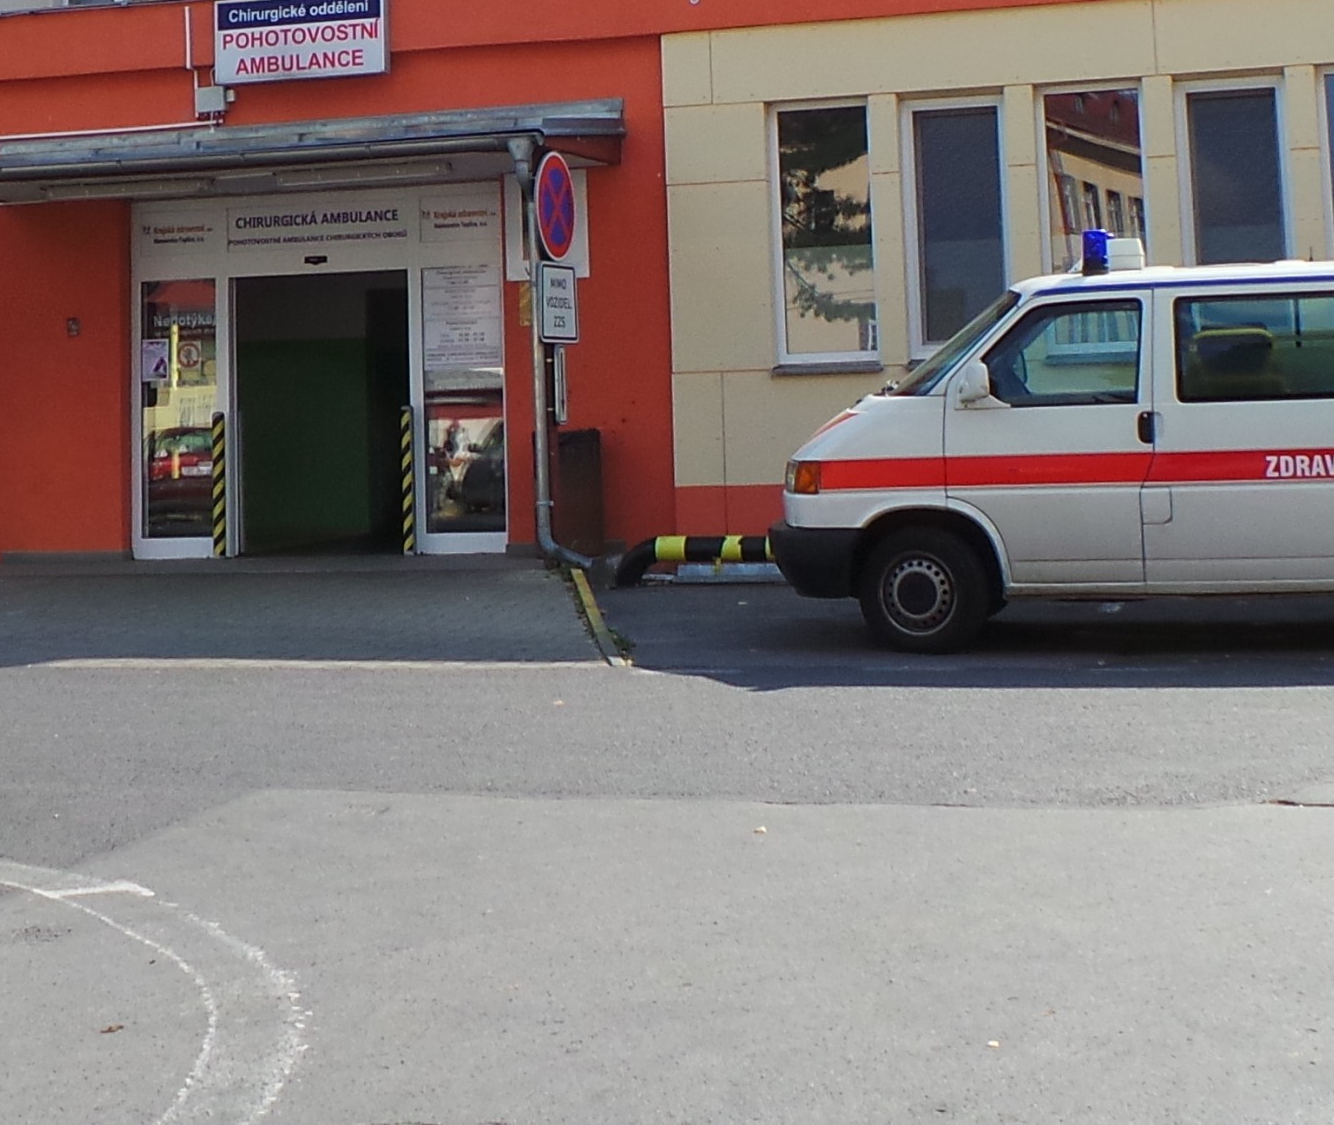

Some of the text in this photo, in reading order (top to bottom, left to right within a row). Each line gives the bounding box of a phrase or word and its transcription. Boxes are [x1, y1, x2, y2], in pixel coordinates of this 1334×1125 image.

[228, 4, 306, 23] Chirurgické
[223, 17, 380, 50] POHOTOVOSTNÍ
[236, 49, 364, 75] AMBULANCE
[235, 209, 399, 229] CHIRURGICKÁ AMBULANCE
[550, 278, 567, 290] MIMO
